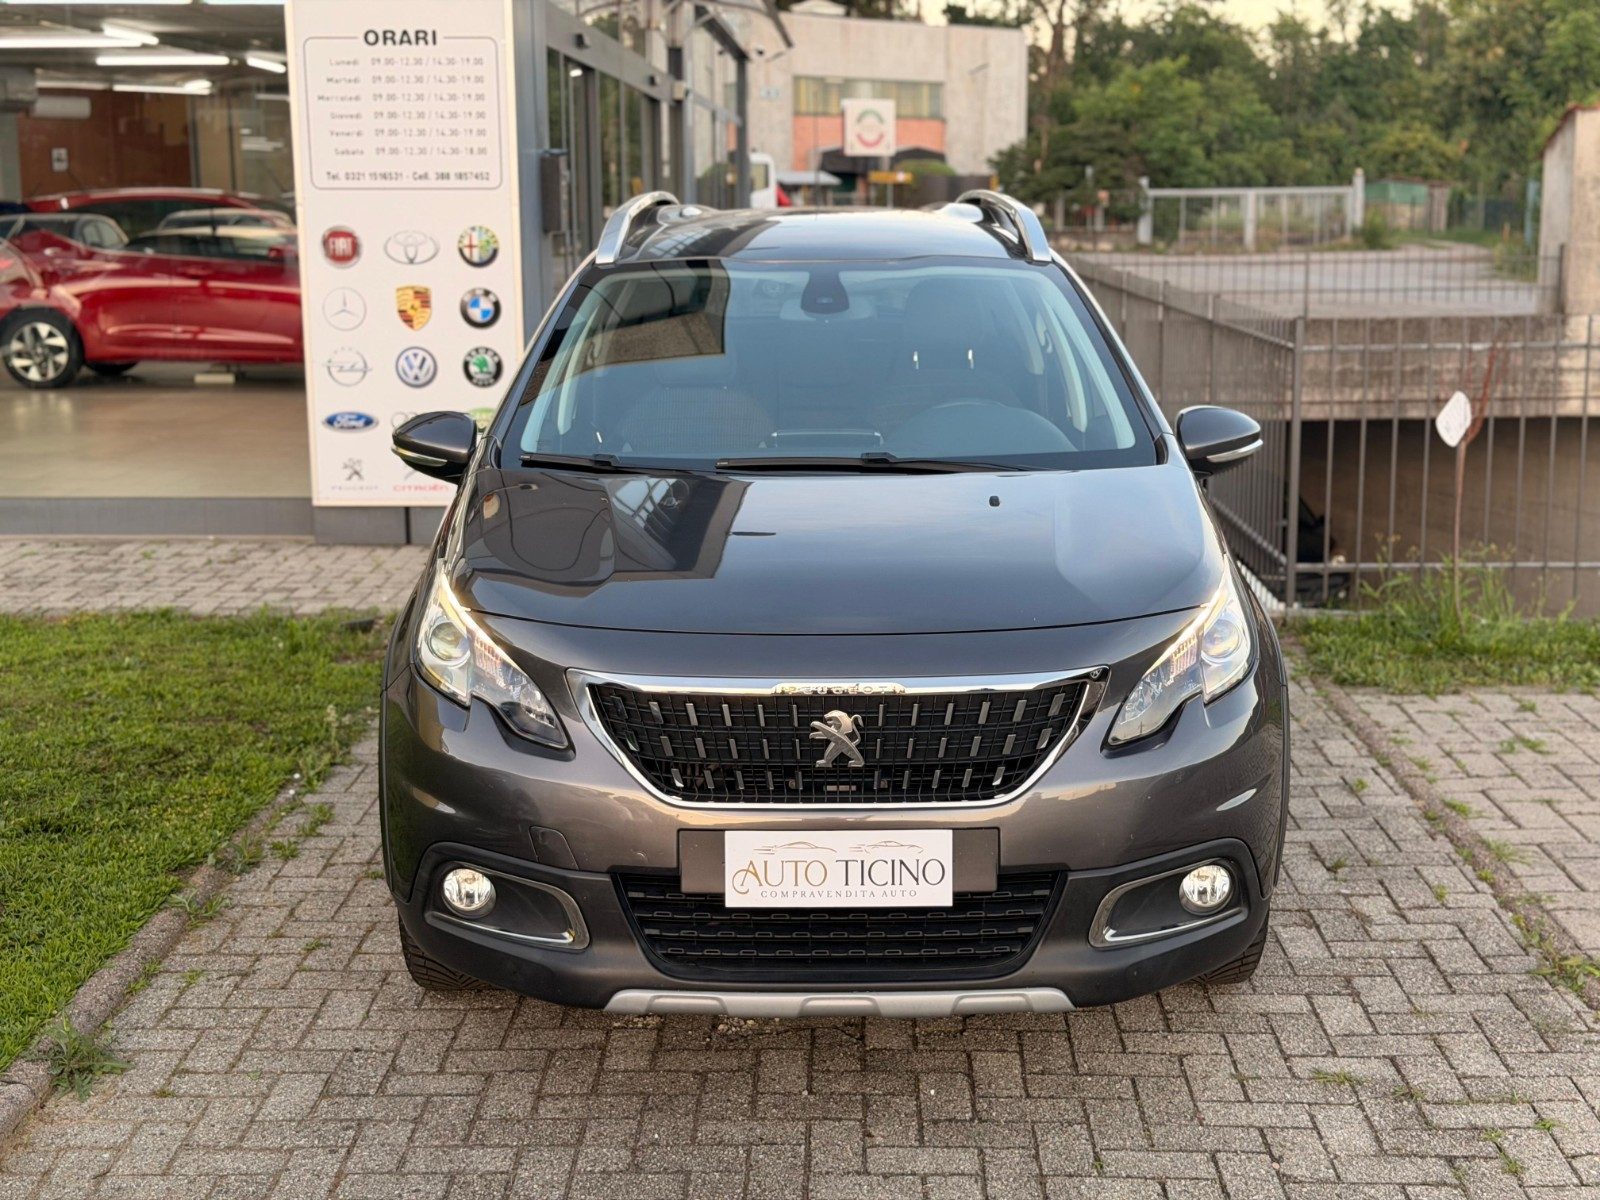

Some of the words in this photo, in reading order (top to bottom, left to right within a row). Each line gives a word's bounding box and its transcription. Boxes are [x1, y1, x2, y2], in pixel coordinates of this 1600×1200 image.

[364, 29, 438, 46] ORARI
[328, 236, 352, 257] FIAT
[333, 413, 367, 429] Ford
[732, 859, 828, 895] AUTO
[836, 858, 946, 887] TICINO
[760, 890, 876, 899] COMPRAVENDITA
[882, 889, 918, 898] AUTO
